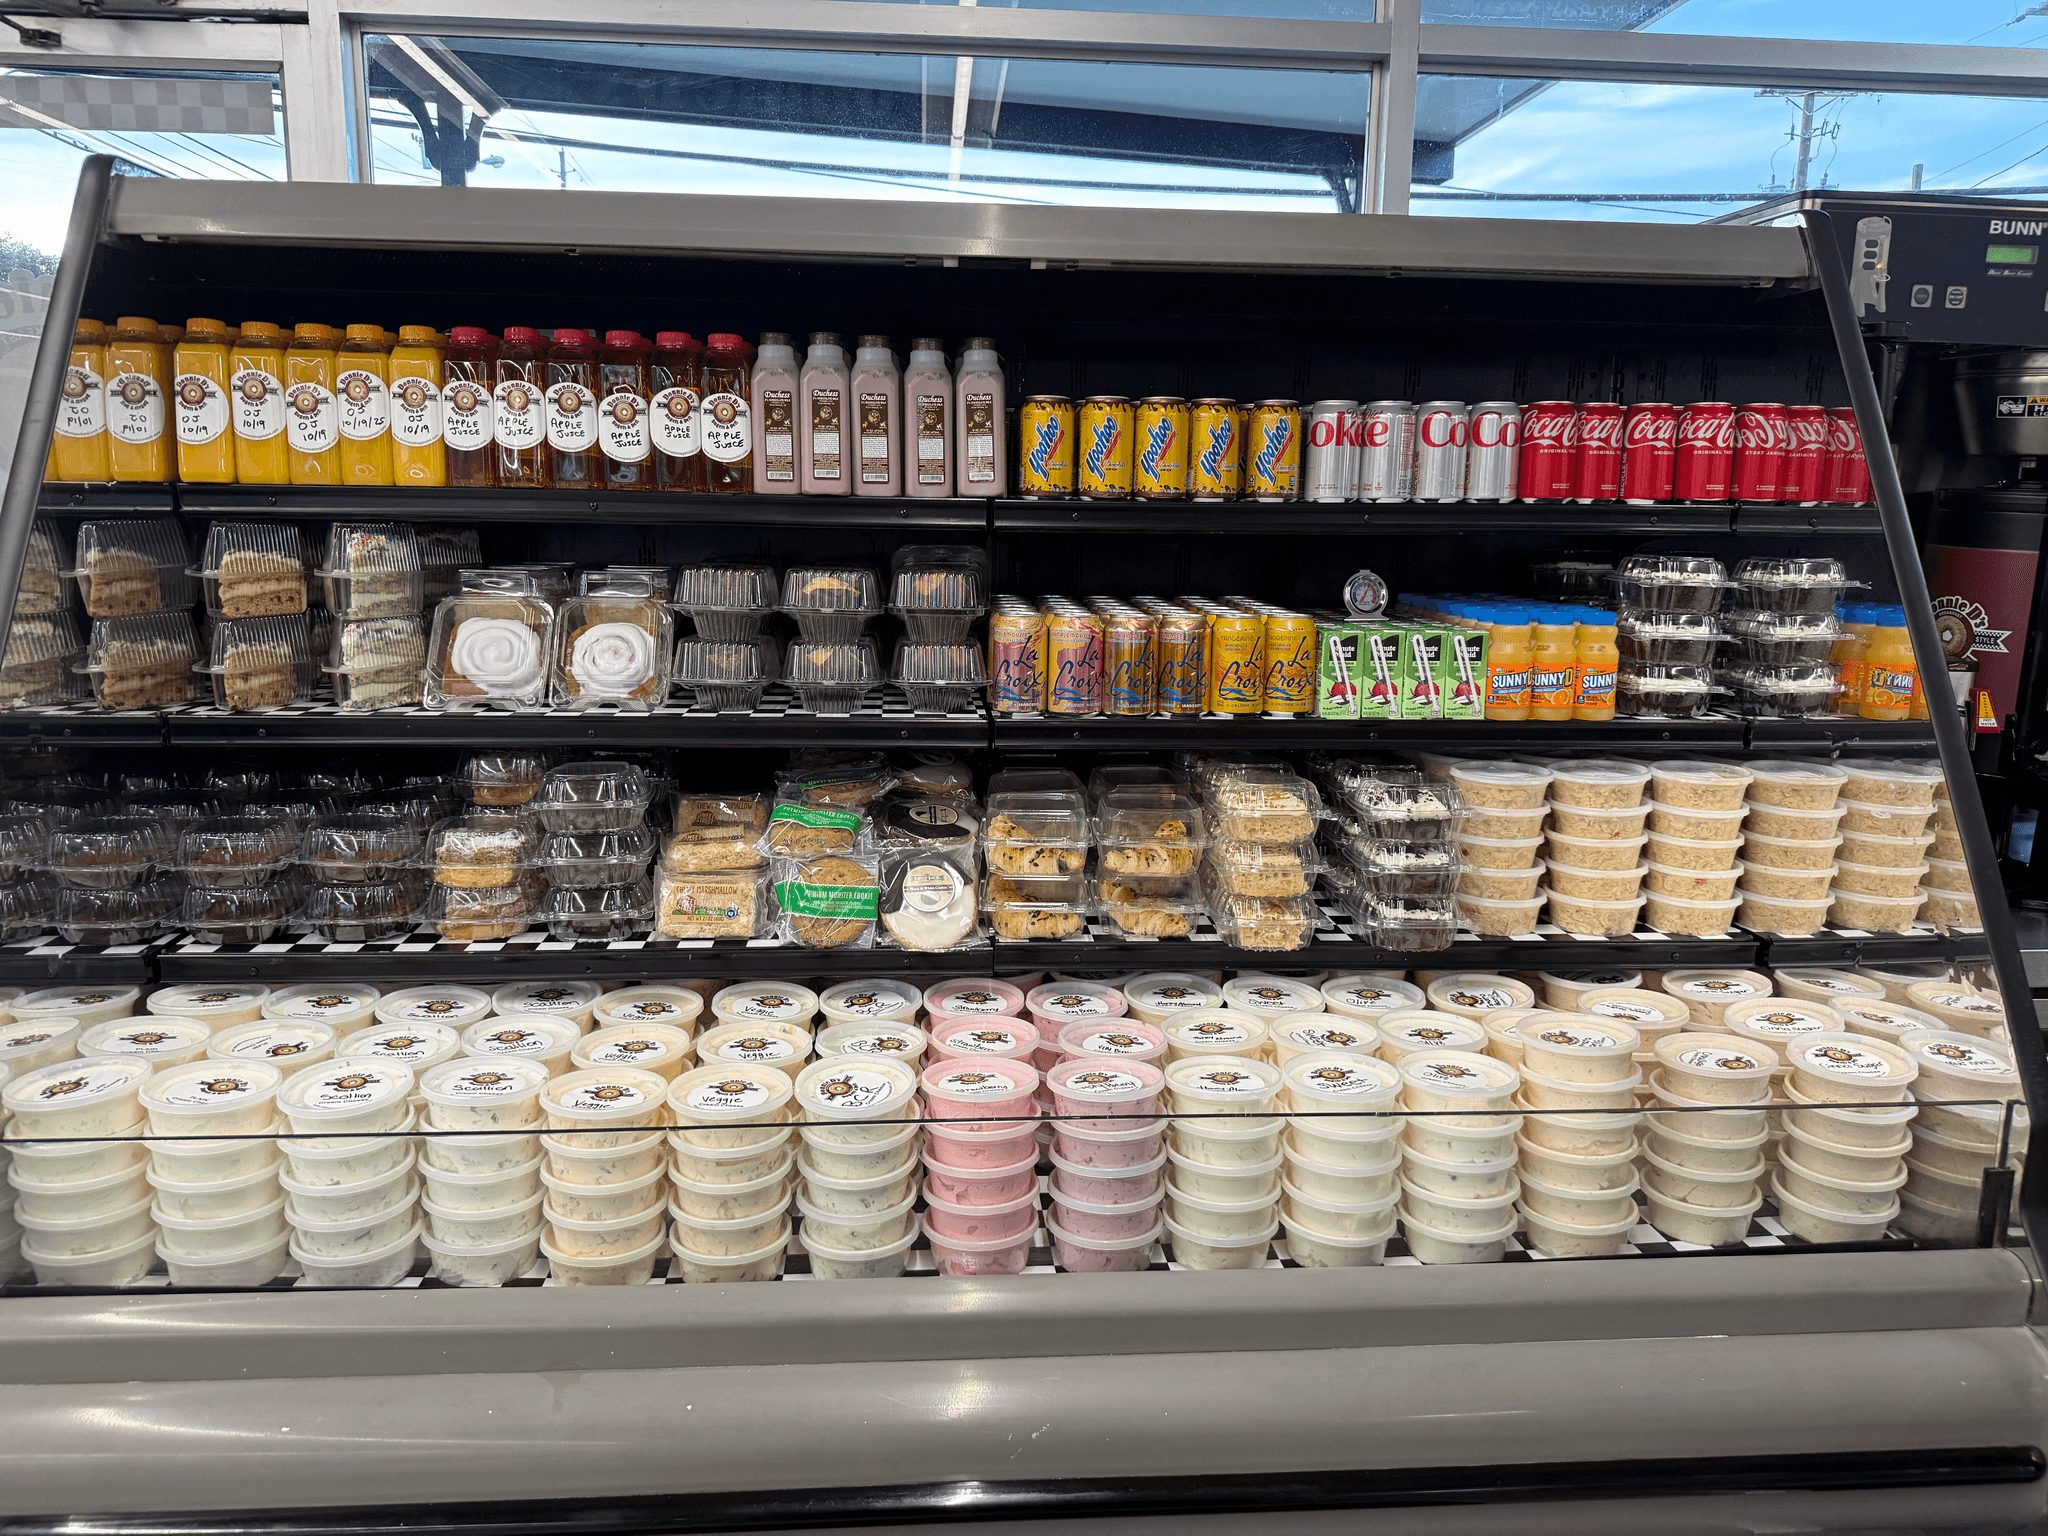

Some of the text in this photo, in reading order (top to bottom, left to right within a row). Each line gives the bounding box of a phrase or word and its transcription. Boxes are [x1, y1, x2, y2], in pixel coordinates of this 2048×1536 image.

[1989, 220, 2042, 236] BUNN
[177, 375, 200, 389] Donnie
[236, 372, 262, 383] Donnie
[397, 379, 422, 392] Donnie
[450, 383, 473, 394] Donnie
[553, 384, 578, 395] Donnie
[288, 385, 311, 398] Donnie
[662, 389, 686, 401] Donnie
[813, 389, 838, 397] Duchess
[607, 395, 631, 407] Donnie
[708, 395, 732, 406] Donnie
[182, 415, 199, 423] OJ
[342, 417, 385, 429] 10/19/25
[408, 414, 425, 422] OJ
[448, 417, 478, 428] APPLE
[498, 416, 528, 426] APPLE
[551, 418, 582, 429] APPLE
[182, 425, 208, 434] 10/19
[243, 420, 265, 429] 10/19
[403, 425, 430, 434] 10/19
[665, 424, 690, 433] APPLE
[1421, 410, 1470, 448] Co
[1472, 410, 1520, 448] Co
[303, 429, 327, 441] 10/19
[505, 427, 533, 436] JUICE
[556, 429, 586, 438] JUICE
[611, 430, 641, 440] APPLE
[708, 431, 741, 440] APPLE
[615, 439, 642, 448] JUICE
[714, 440, 744, 449] JUICE
[1931, 596, 1969, 613] onnie
[1976, 636, 1995, 644] STYLE
[1013, 635, 1039, 669] La
[1077, 636, 1099, 669] La
[1134, 636, 1154, 669] La
[1177, 636, 1202, 669] La
[1244, 636, 1263, 669] La
[1288, 636, 1310, 669] La
[994, 659, 1046, 696] Croix
[1158, 661, 1208, 696] Croix
[1264, 660, 1316, 696] Croix
[697, 886, 738, 894] MARSHMALLOW
[523, 1000, 580, 1008] Scallion
[953, 1005, 999, 1013] Strawberry
[744, 1006, 774, 1015] Veggie
[488, 1040, 543, 1051] Scallion
[604, 1053, 638, 1061] Veggie
[738, 1051, 780, 1060] Veggie
[1855, 1060, 1884, 1072] Sugar
[1423, 1072, 1449, 1080] Olive
[451, 1084, 513, 1092] Scallion
[1316, 1078, 1368, 1089] Sweet
[841, 1086, 879, 1107] BCR
[573, 1099, 611, 1110] Veggie
